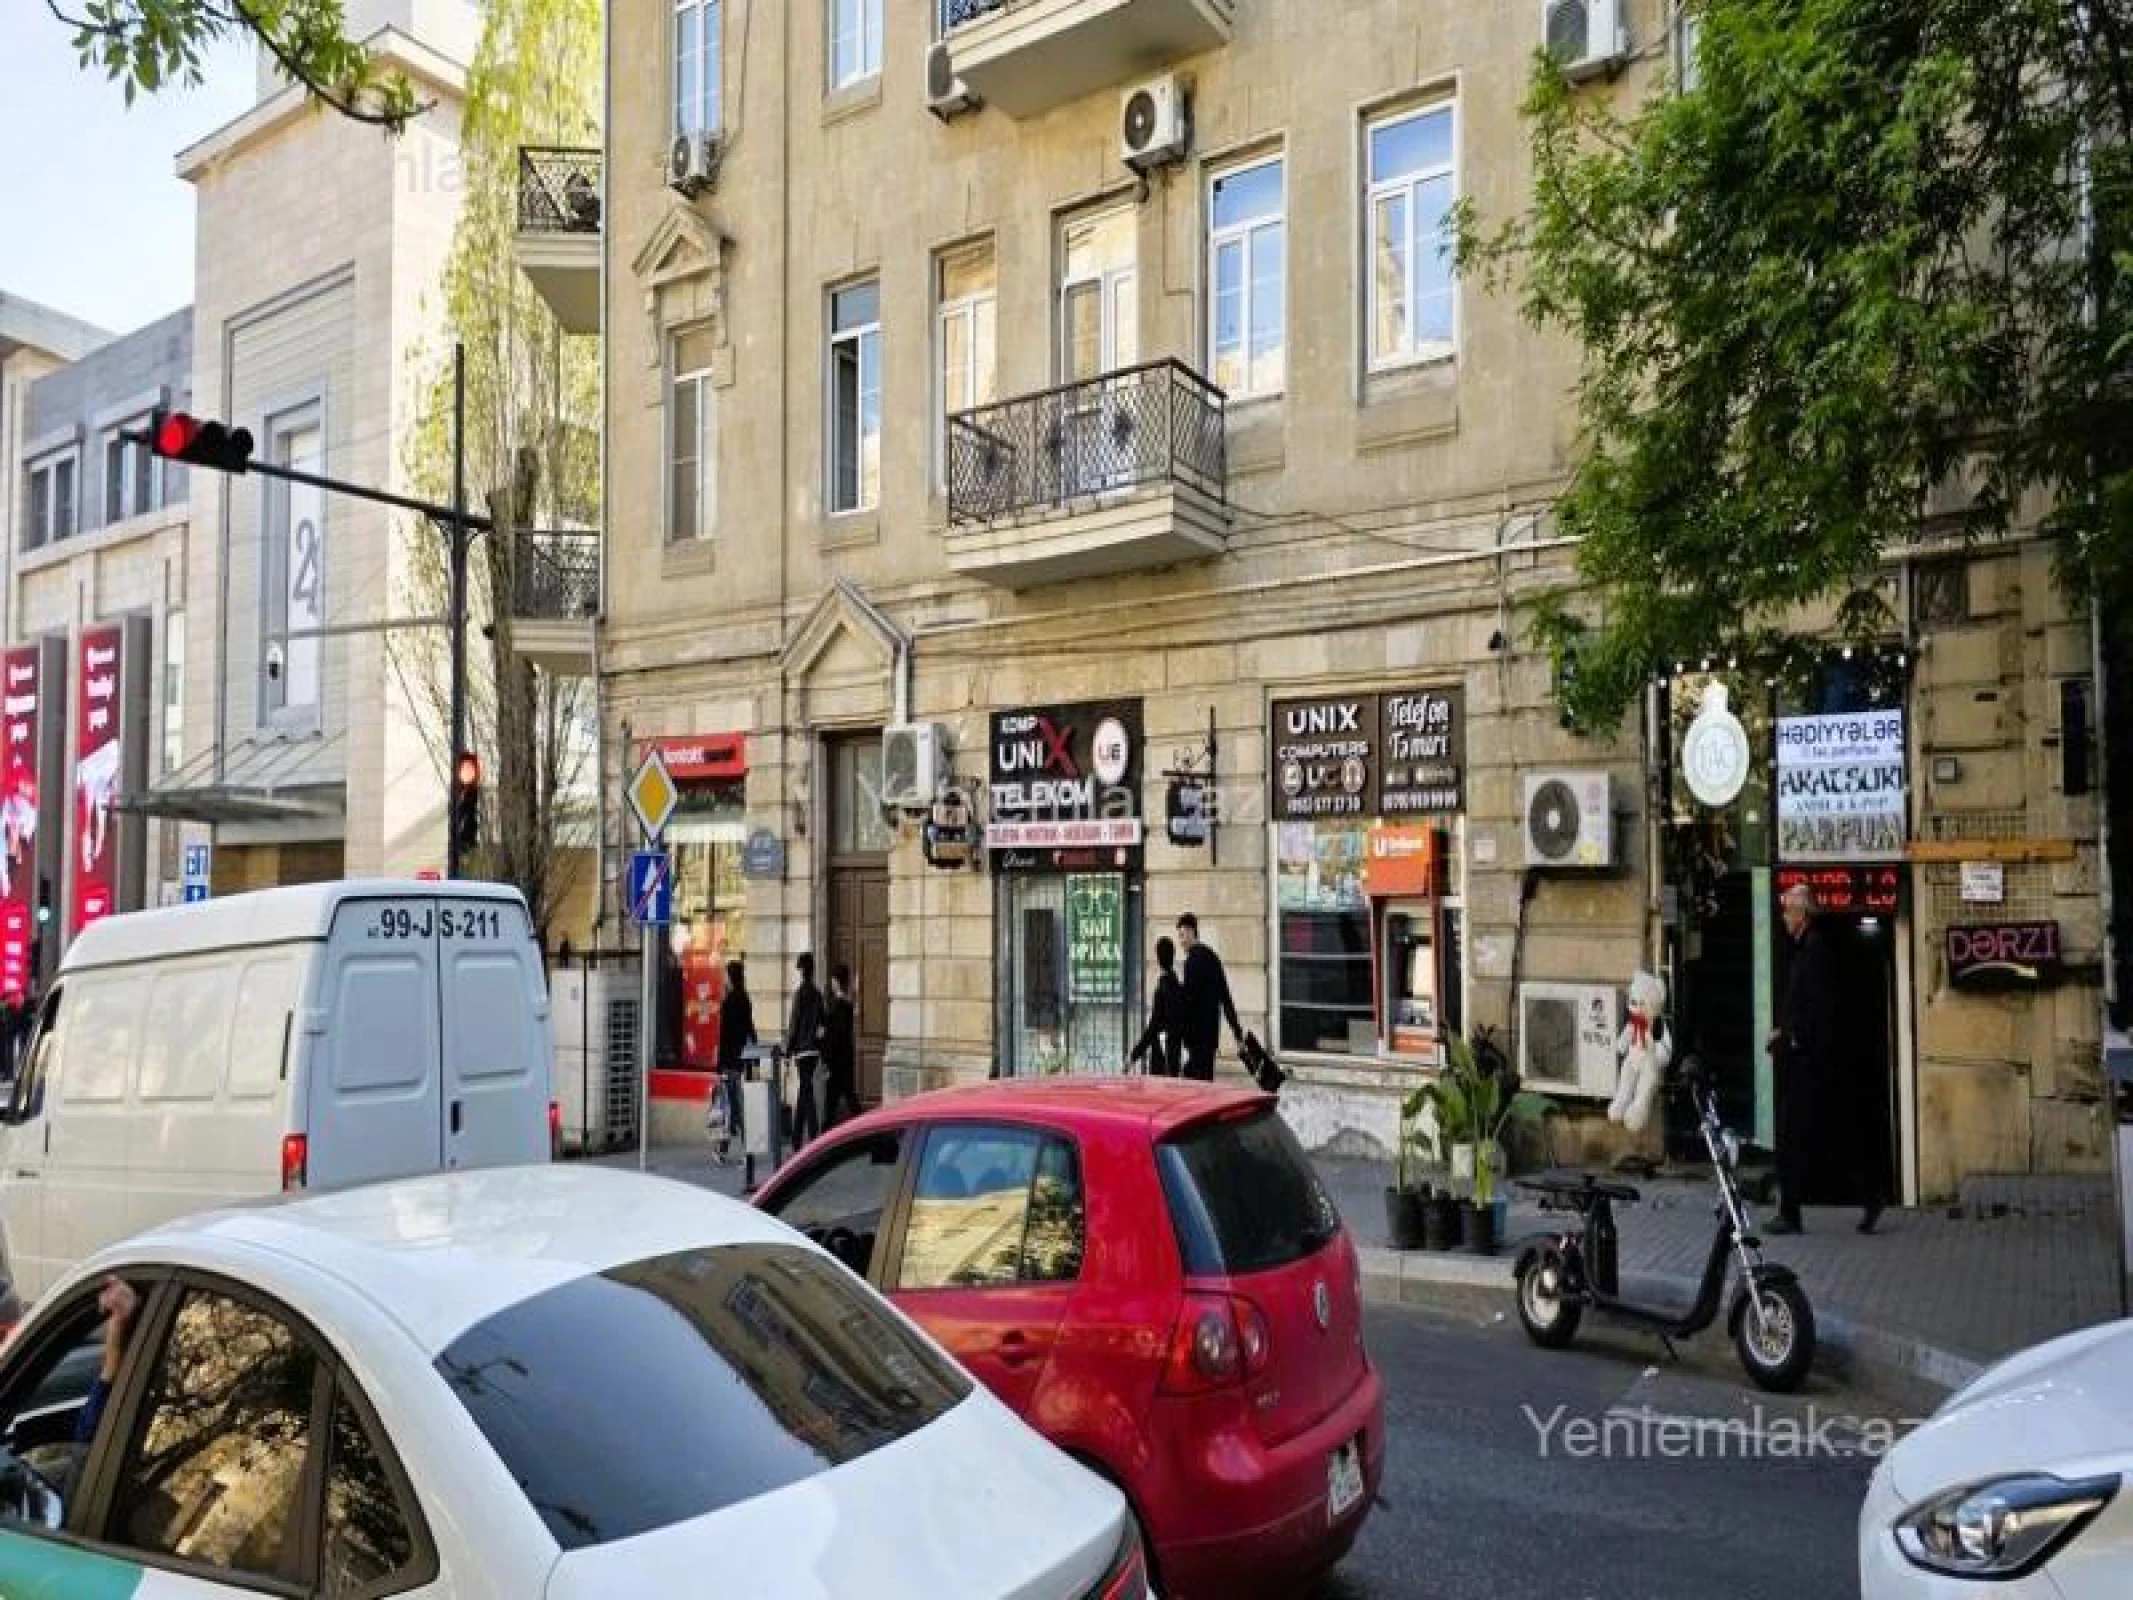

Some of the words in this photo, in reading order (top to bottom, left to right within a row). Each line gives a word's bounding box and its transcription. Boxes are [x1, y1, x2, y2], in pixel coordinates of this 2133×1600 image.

[1288, 704, 1358, 734] UNIX
[1387, 694, 1448, 732] Telefon
[991, 778, 1092, 809] TELEKOM
